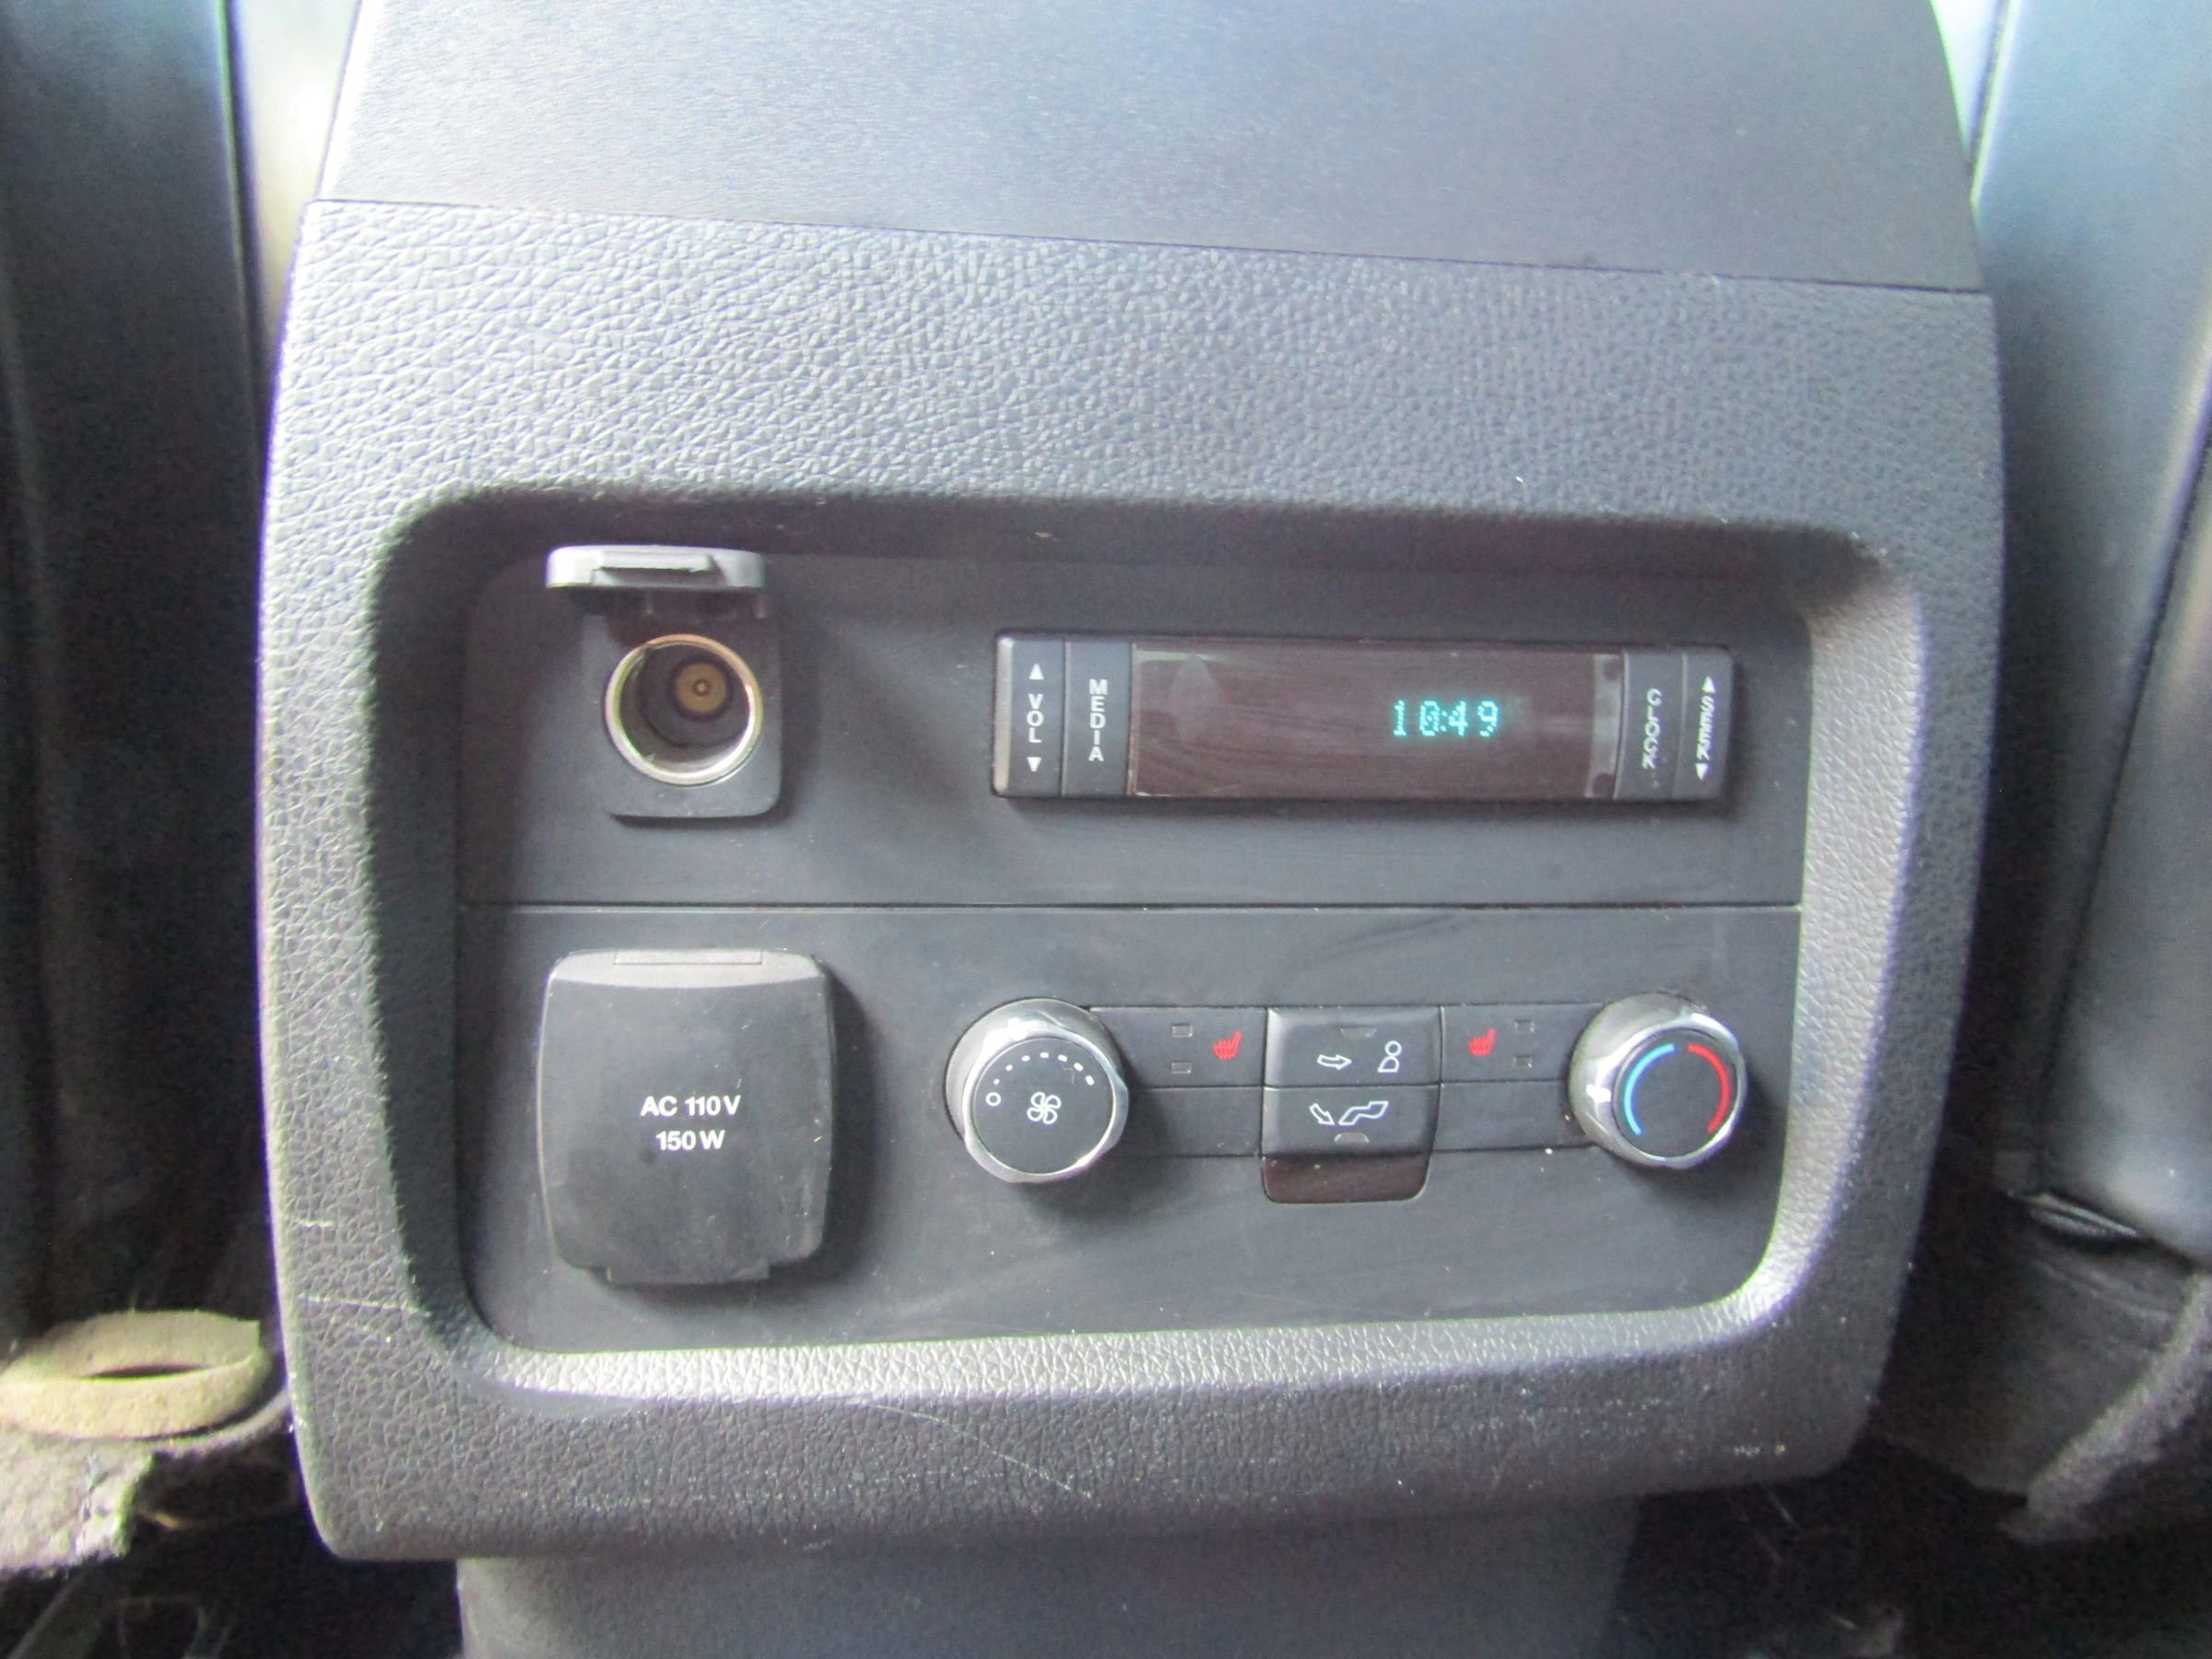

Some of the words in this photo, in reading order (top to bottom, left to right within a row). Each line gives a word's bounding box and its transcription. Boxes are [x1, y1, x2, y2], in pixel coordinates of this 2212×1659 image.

[1026, 693, 1044, 743] VOL
[1088, 678, 1109, 762] MEDIA
[1393, 700, 1499, 737] 10:49
[1641, 688, 1662, 770] CLOCK
[641, 1095, 677, 1117] AC
